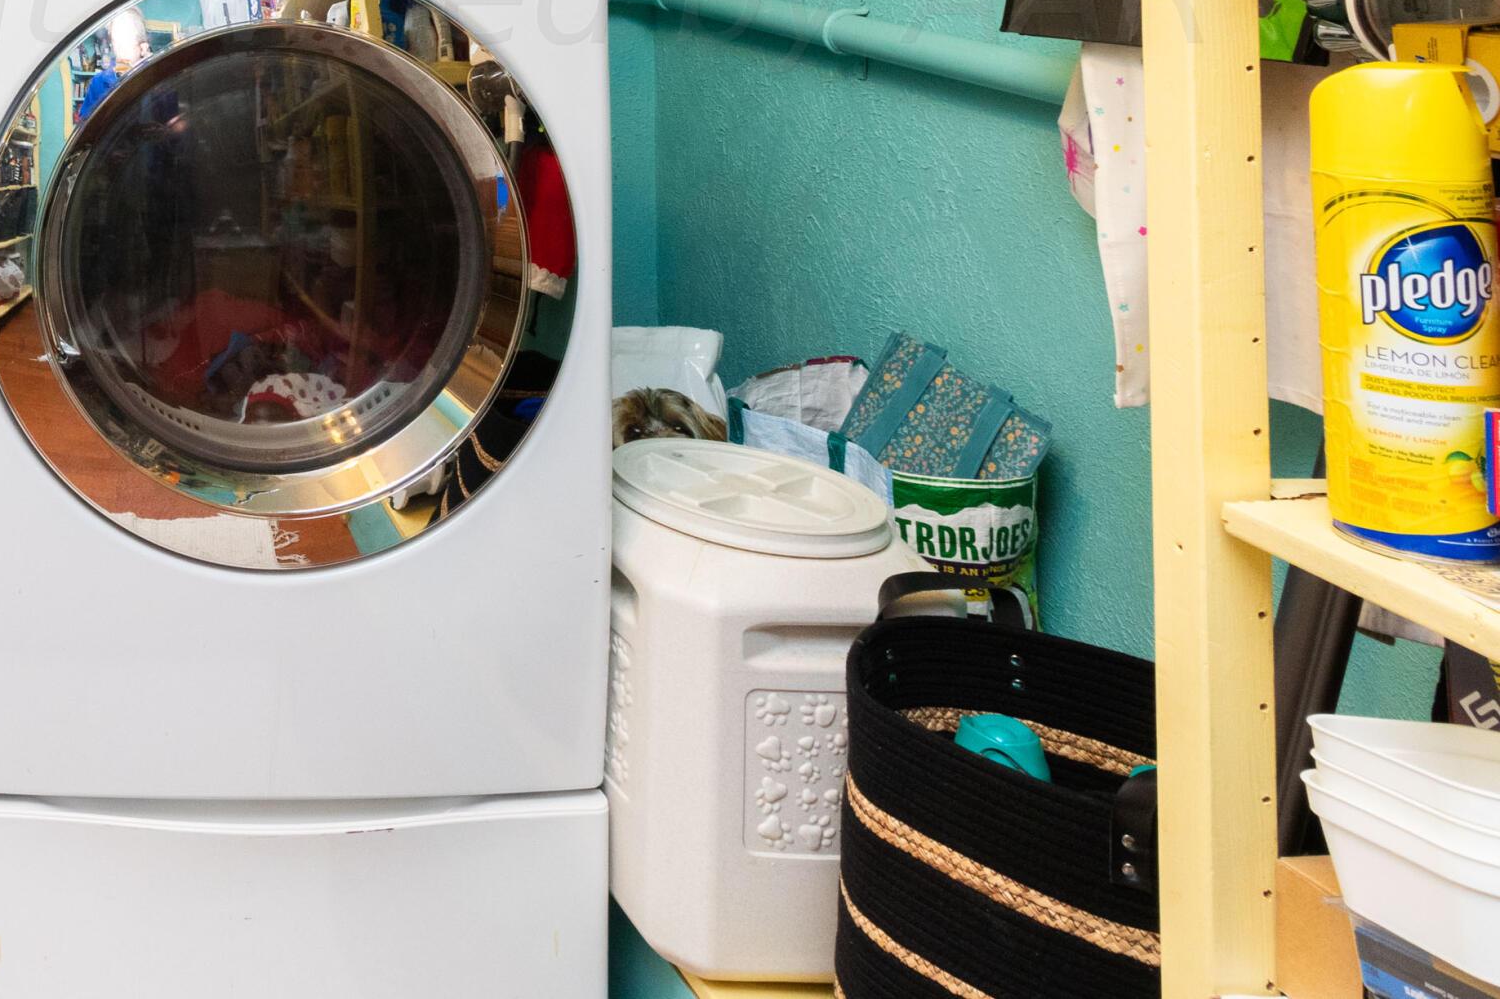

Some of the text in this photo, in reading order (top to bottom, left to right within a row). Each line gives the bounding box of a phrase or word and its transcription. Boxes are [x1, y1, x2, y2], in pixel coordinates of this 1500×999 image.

[1359, 258, 1492, 325] pledge
[1414, 316, 1453, 326] Furniture
[1422, 324, 1447, 334] Spray
[1365, 344, 1447, 368] LEMON
[1365, 359, 1414, 376] LIMPIEZA
[1416, 368, 1433, 377] DE
[942, 565, 955, 574] IS
[959, 567, 979, 577] AN
